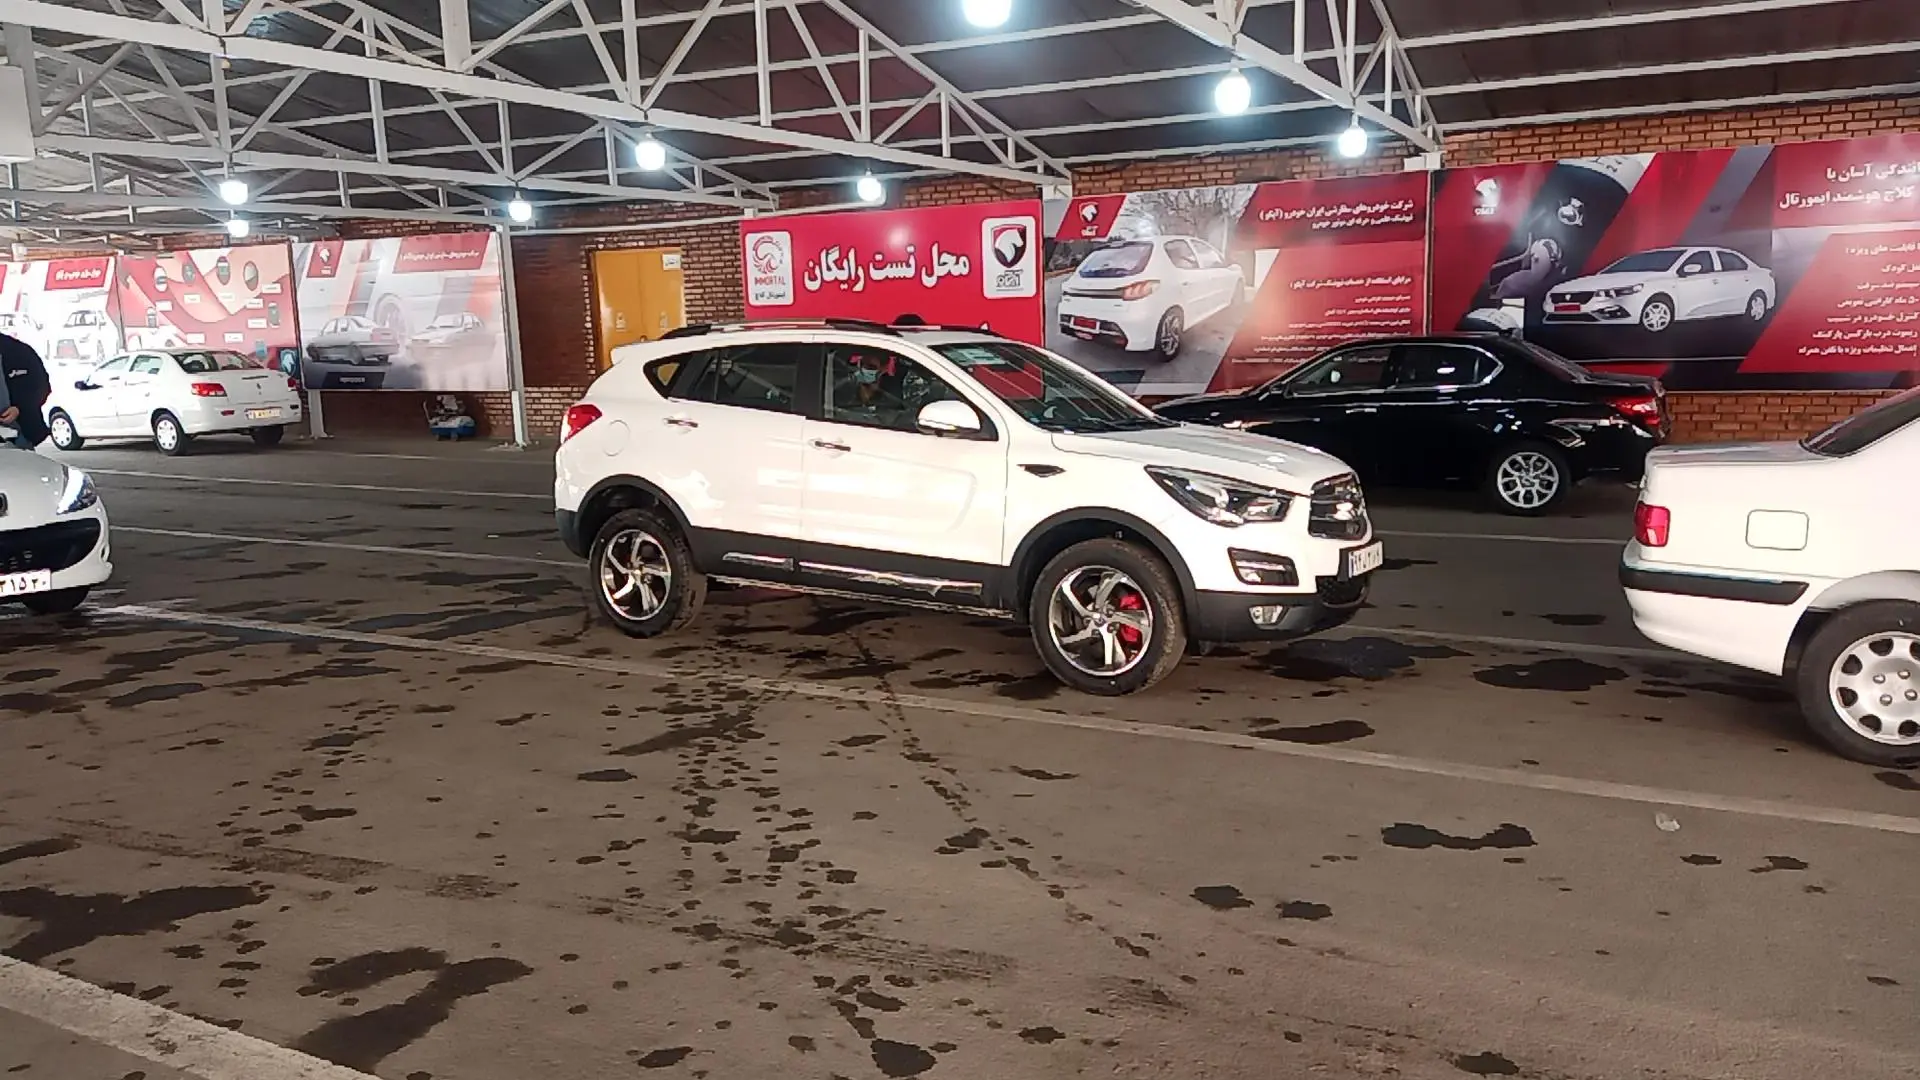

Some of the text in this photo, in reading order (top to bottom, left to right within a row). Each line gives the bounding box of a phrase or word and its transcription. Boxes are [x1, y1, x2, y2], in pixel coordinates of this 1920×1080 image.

[1826, 167, 1837, 182] با
[1837, 163, 1871, 183] آسان
[1390, 199, 1414, 212] شرکت
[1779, 185, 1915, 209] کلاچ هوشمند ایمورتال
[1306, 206, 1326, 219] ایران
[803, 241, 971, 293] محل تست رایگان
